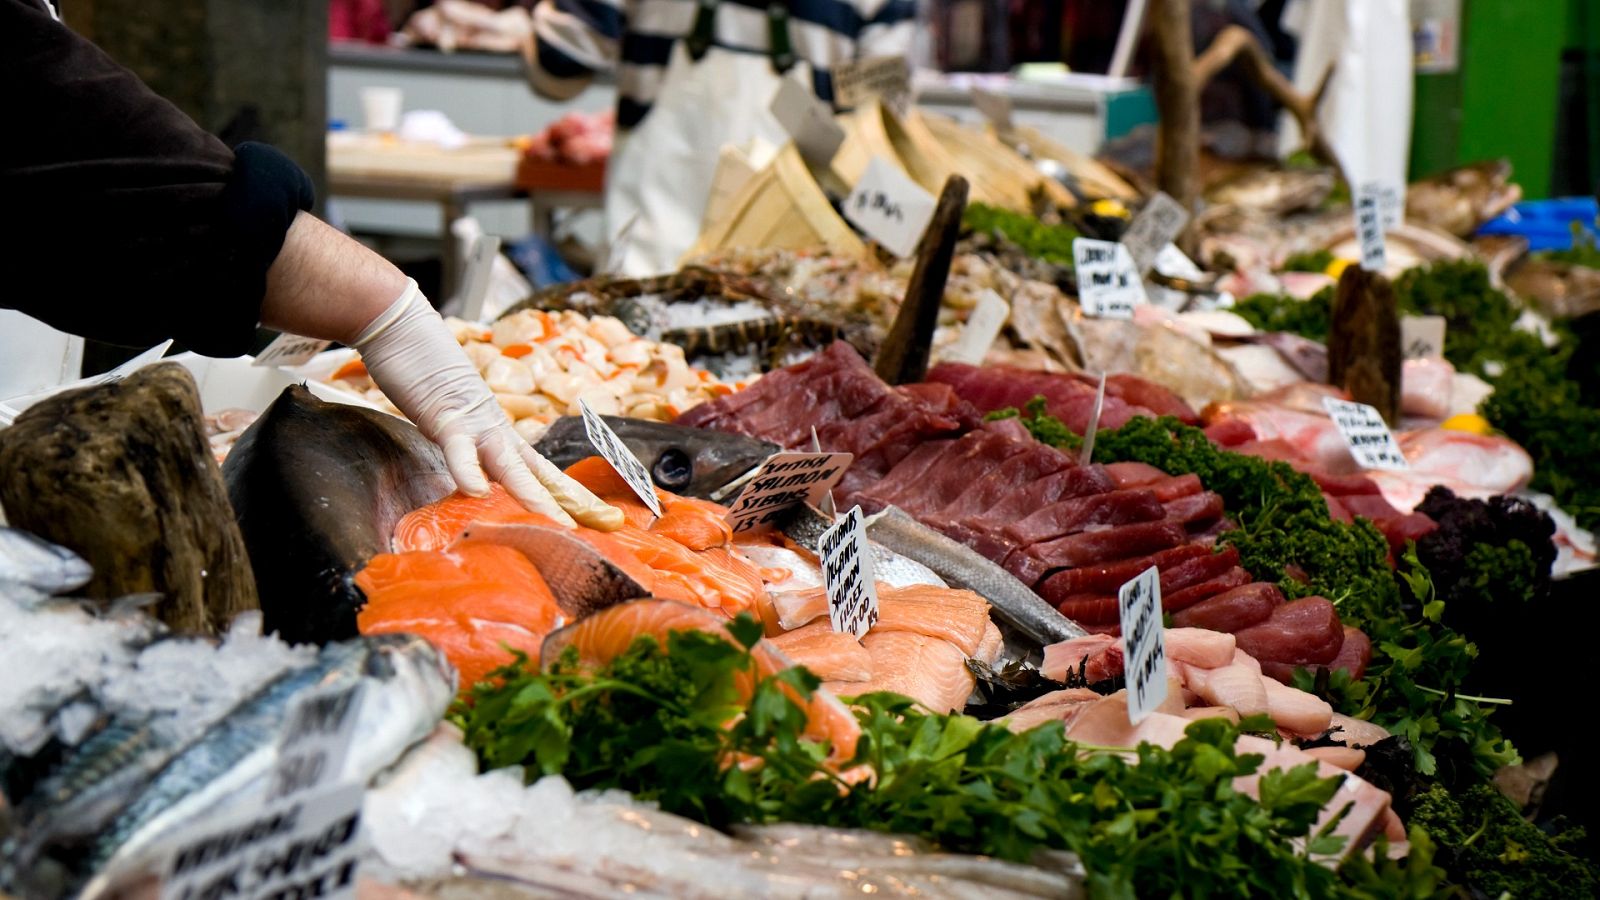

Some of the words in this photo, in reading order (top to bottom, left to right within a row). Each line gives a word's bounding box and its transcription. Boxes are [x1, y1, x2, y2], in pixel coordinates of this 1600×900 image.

[732, 487, 811, 514] STEAKS
[743, 466, 841, 495] SALMON
[826, 535, 859, 591] ORGANIC
[831, 556, 860, 618] SALMON
[839, 580, 863, 632] FILLET
